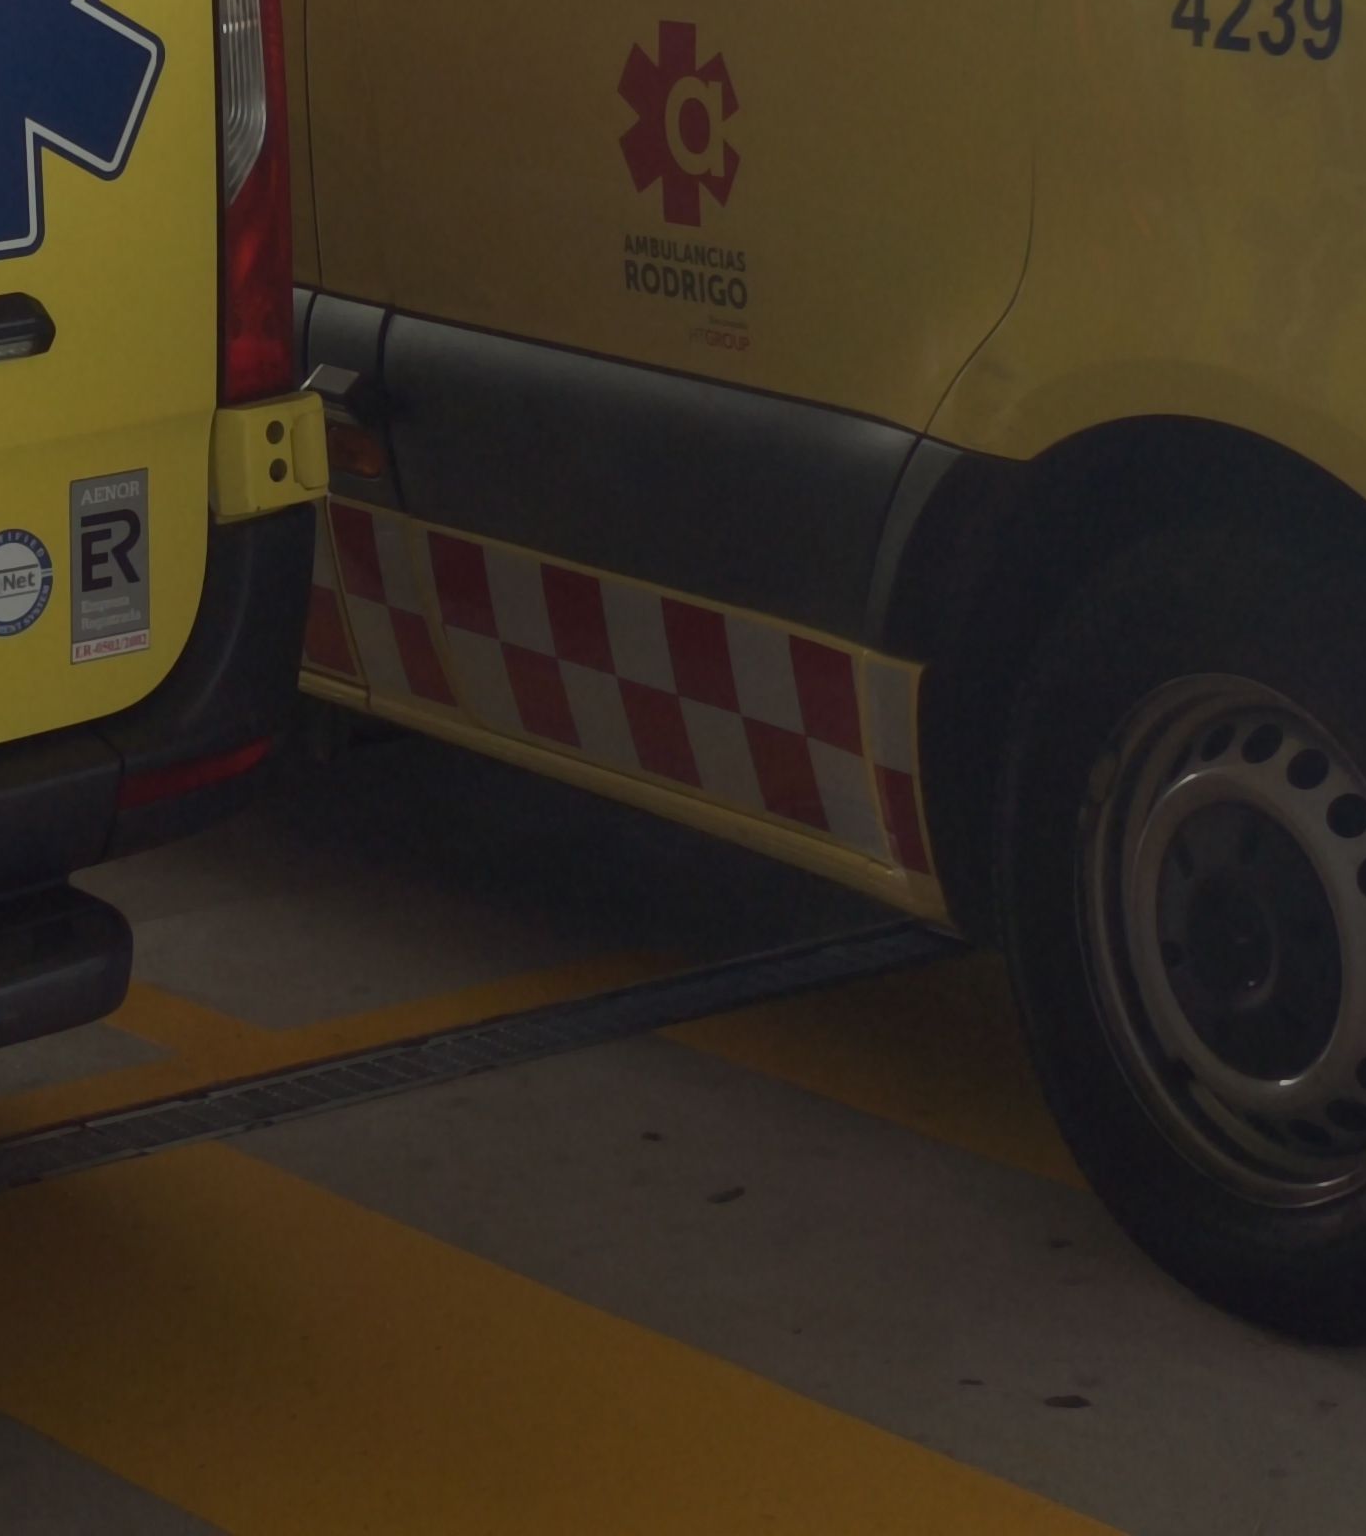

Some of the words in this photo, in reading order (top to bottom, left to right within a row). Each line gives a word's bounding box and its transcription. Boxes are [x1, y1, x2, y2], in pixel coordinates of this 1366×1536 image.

[624, 234, 746, 273] AMBULANCIAS
[624, 260, 748, 310] RODRIGO
[80, 480, 140, 506] AENOR
[81, 509, 141, 593] ER
